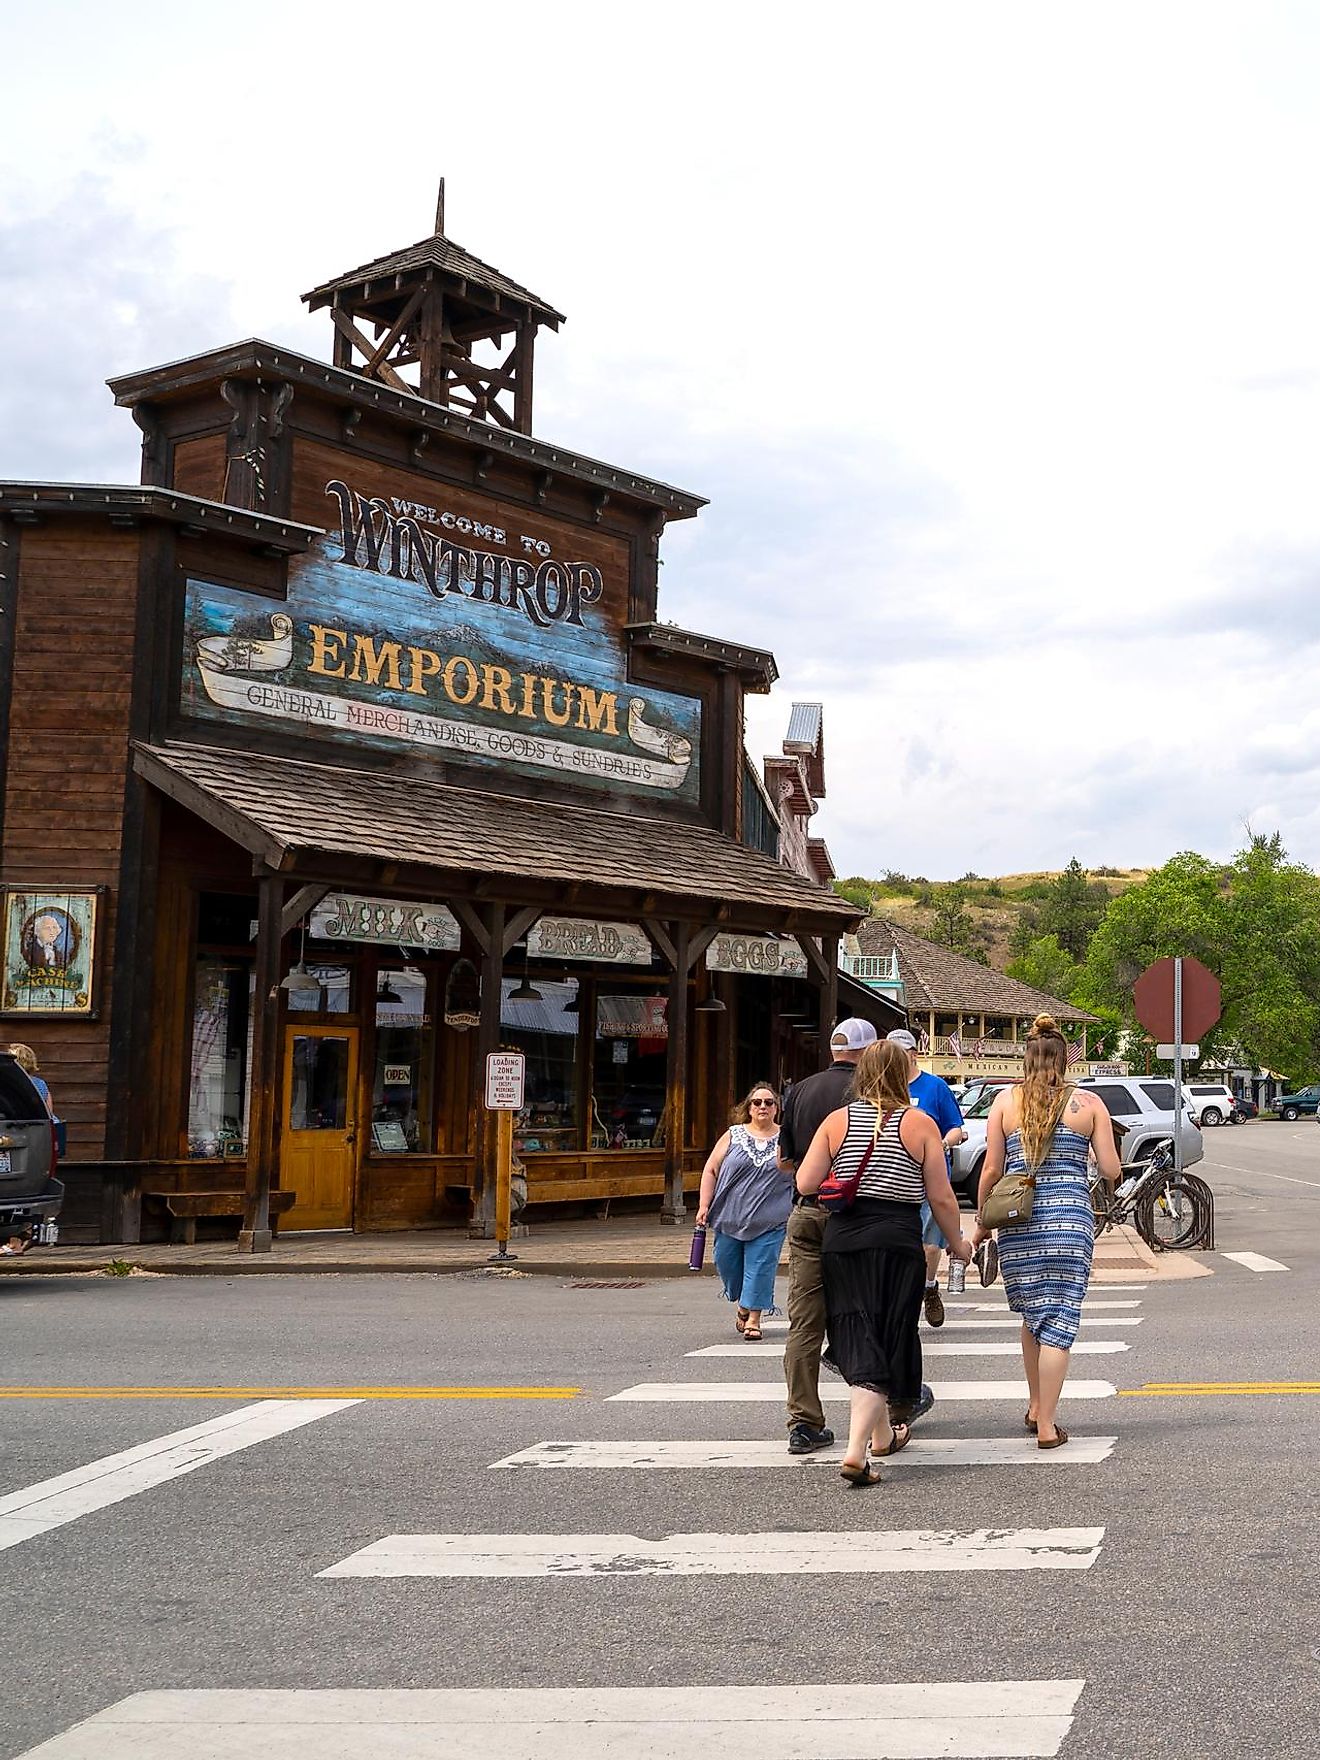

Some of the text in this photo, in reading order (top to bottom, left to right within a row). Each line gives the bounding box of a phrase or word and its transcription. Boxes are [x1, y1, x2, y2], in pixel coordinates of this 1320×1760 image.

[391, 497, 551, 557] WELCOME TO
[325, 479, 604, 628] WINTHROP
[307, 624, 620, 736] EMPORIUM
[247, 685, 337, 720] GENERAL
[487, 733, 546, 760] GOODS
[552, 746, 564, 767] &
[572, 750, 652, 779] SUNDRIES
[325, 899, 424, 944] MILK
[538, 921, 623, 959] BREAD
[715, 937, 781, 972] EGGS
[385, 1069, 410, 1081] OPEN
[968, 1063, 1008, 1071] MEXICAN
